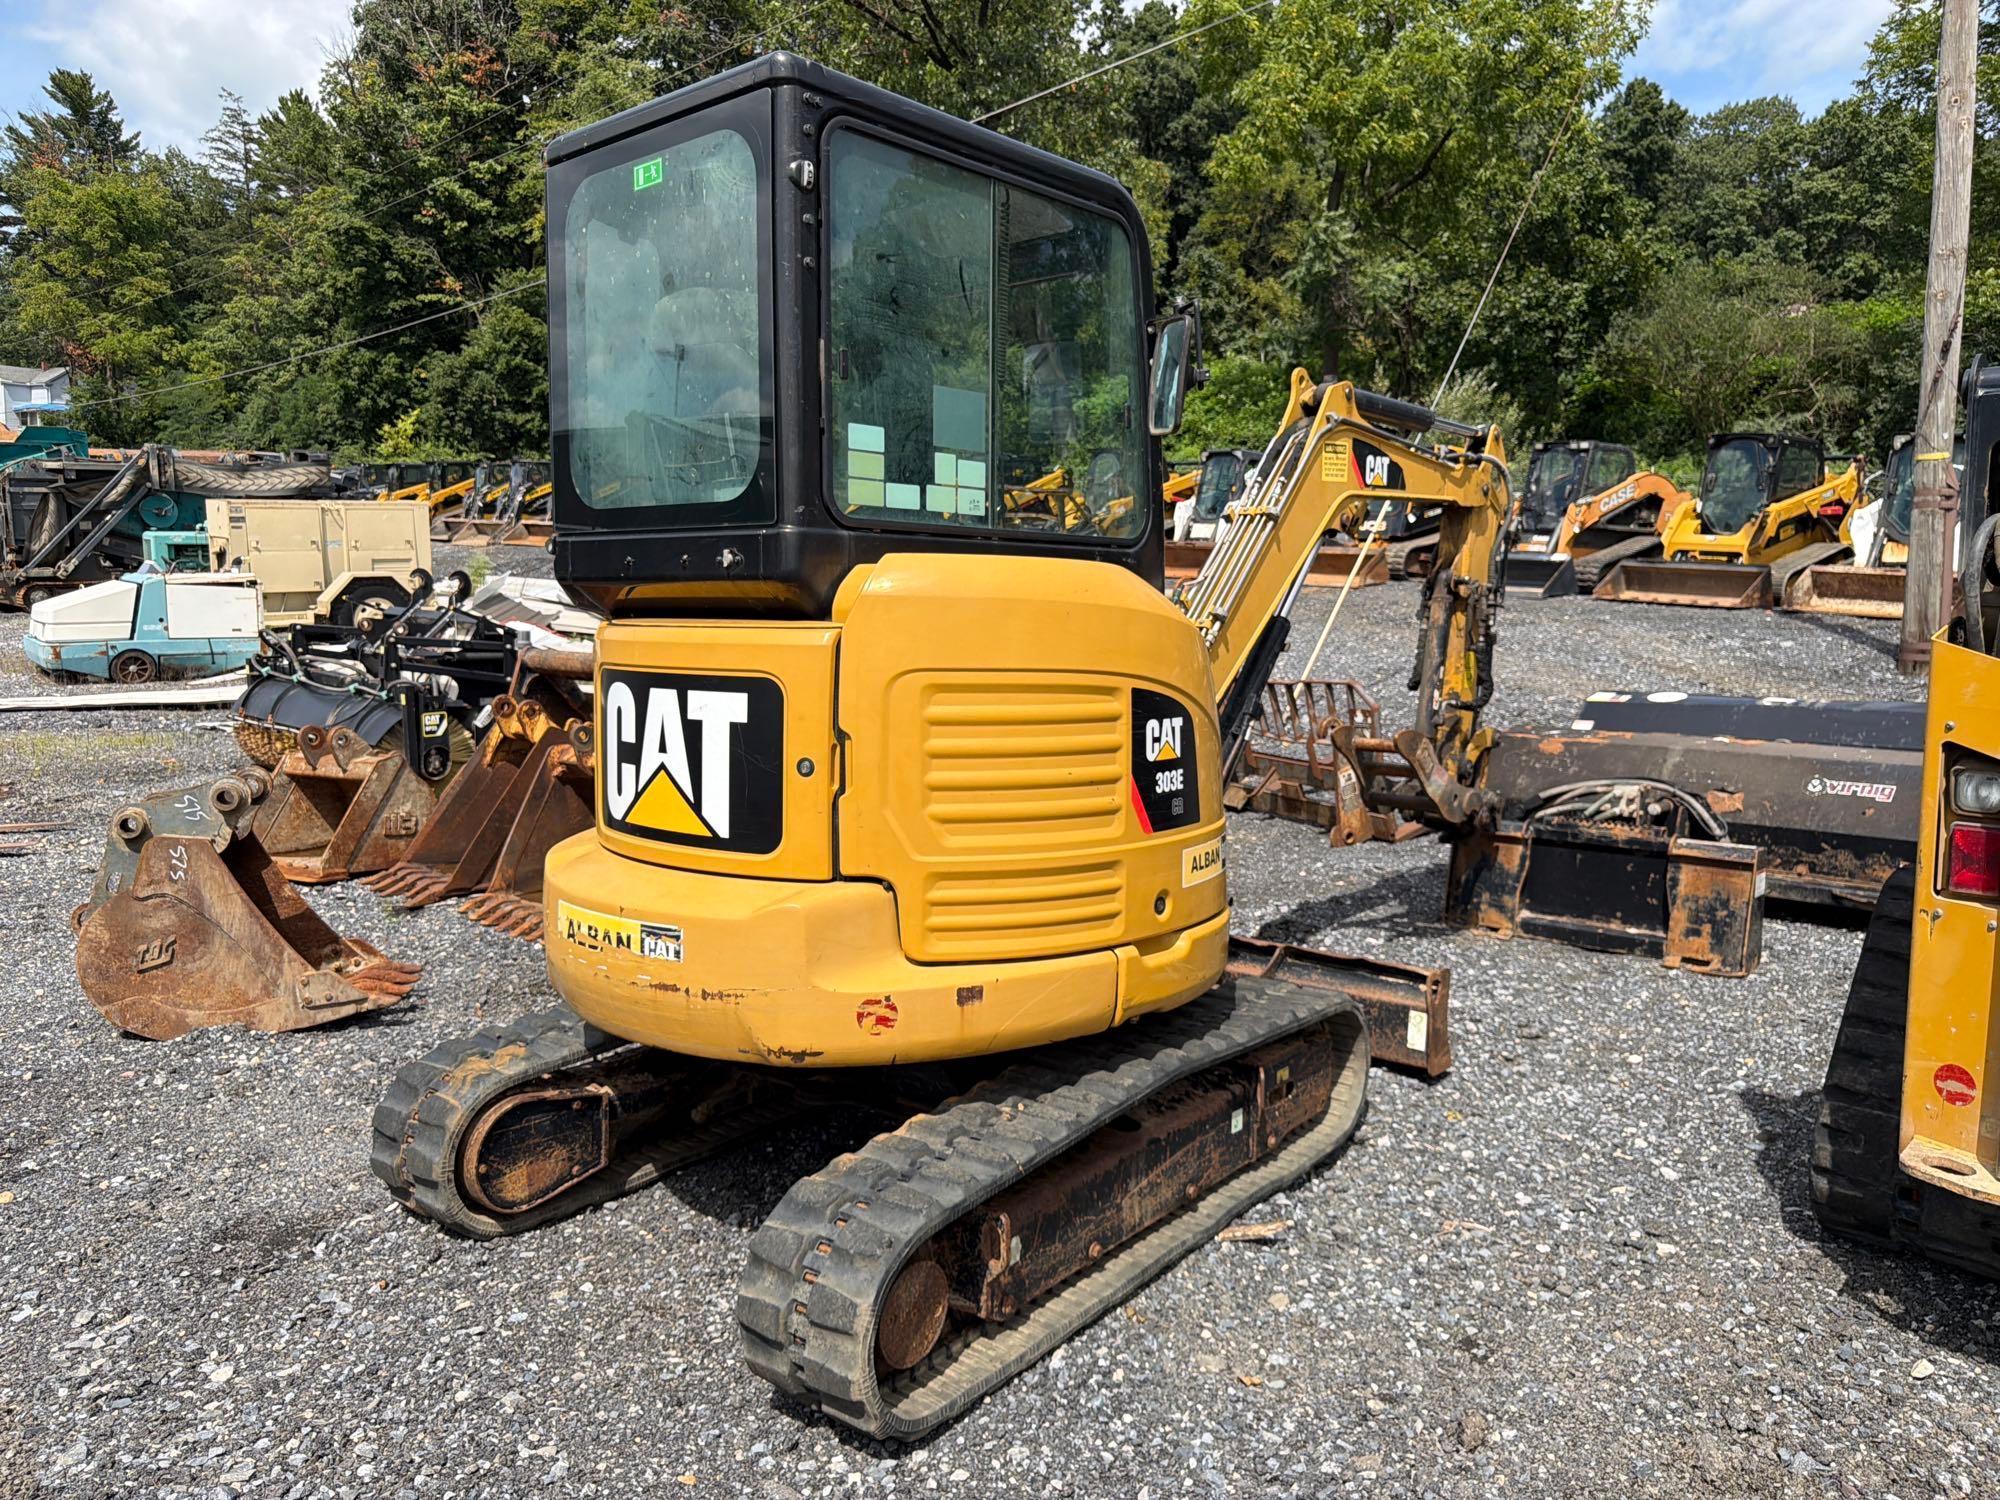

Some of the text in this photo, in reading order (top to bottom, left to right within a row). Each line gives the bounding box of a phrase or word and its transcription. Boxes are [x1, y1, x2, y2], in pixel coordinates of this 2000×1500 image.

[1366, 454, 1390, 486] CAT
[1600, 483, 1636, 511] CASE
[425, 714, 440, 725] CAT
[1146, 717, 1183, 762] CAT
[606, 681, 748, 839] CAT
[1155, 769, 1184, 794] 303E
[1191, 845, 1220, 873] ALBAN
[567, 918, 677, 961] ALBAN CAT
